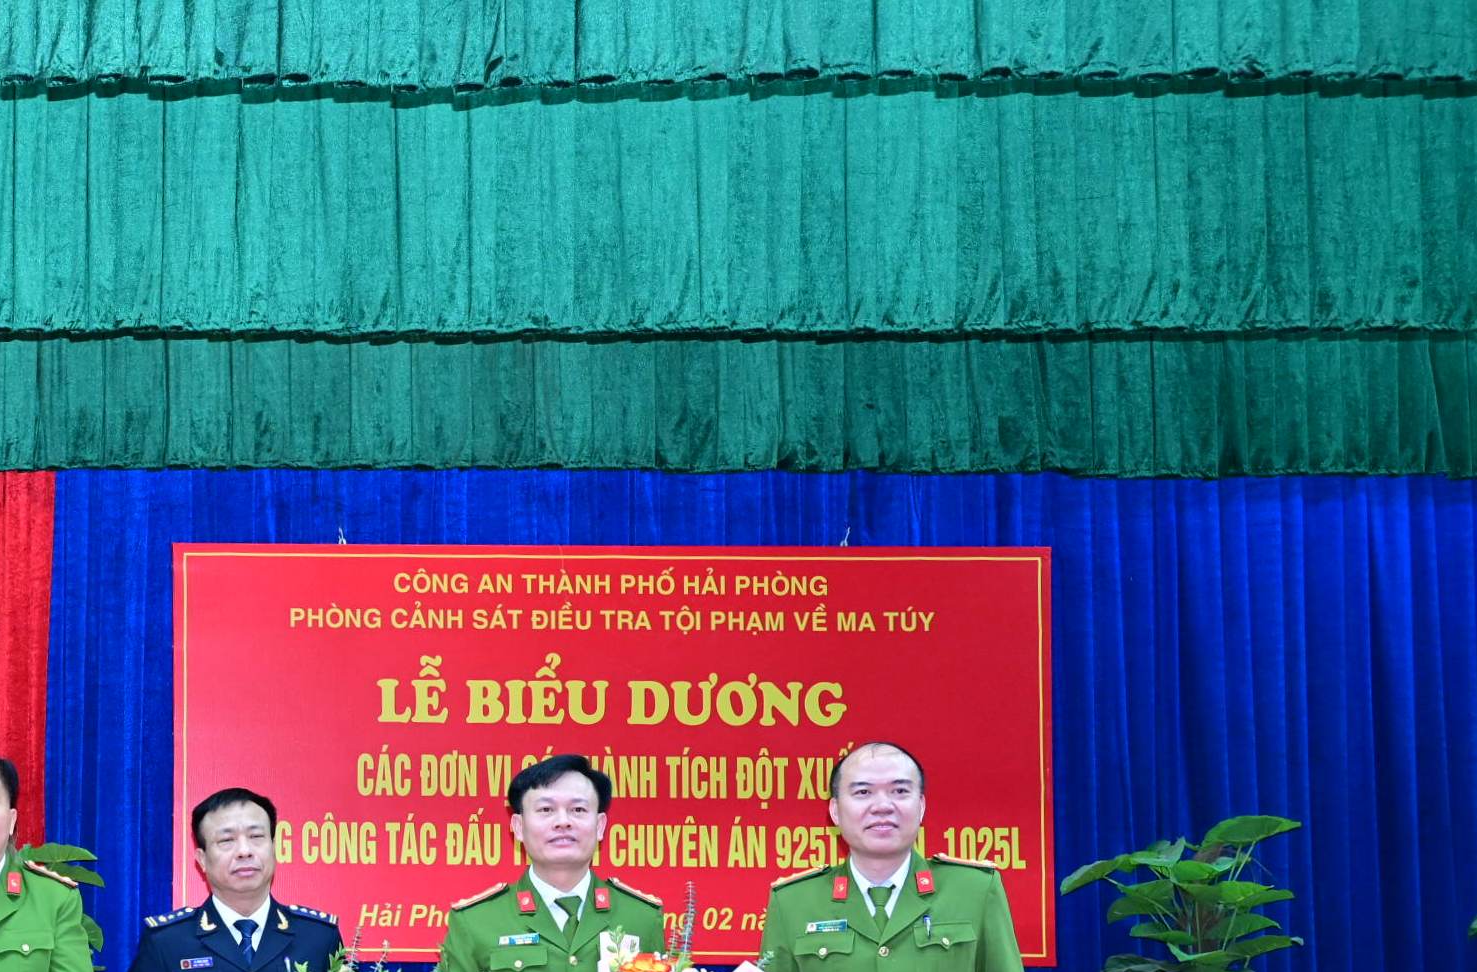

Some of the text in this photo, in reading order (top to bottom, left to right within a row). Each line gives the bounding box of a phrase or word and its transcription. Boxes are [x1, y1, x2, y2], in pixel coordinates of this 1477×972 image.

[394, 567, 828, 596] CÔNG AN THÀNH PHỐ HẢI PHÒNG
[290, 601, 935, 635] PHÒNG CẢNH SÁT ĐIỀU TRA TỘI PHẠM VỀ MA TÚY
[376, 652, 847, 727] LỄ BIỂU DƯƠNG
[357, 744, 412, 796] CÁC
[420, 750, 477, 797] ĐƠN
[486, 754, 512, 807] VỊ
[666, 746, 727, 799] TÍCH
[736, 747, 789, 809] ĐỘT
[302, 812, 377, 865] CÔNG
[386, 813, 437, 866] TÁC
[445, 807, 501, 866] ĐẤU
[609, 816, 718, 868] CHUYÊN
[727, 816, 767, 868] ÁN
[943, 826, 1027, 870] 1025L
[358, 903, 402, 927] Hải
[702, 907, 733, 931] 02
